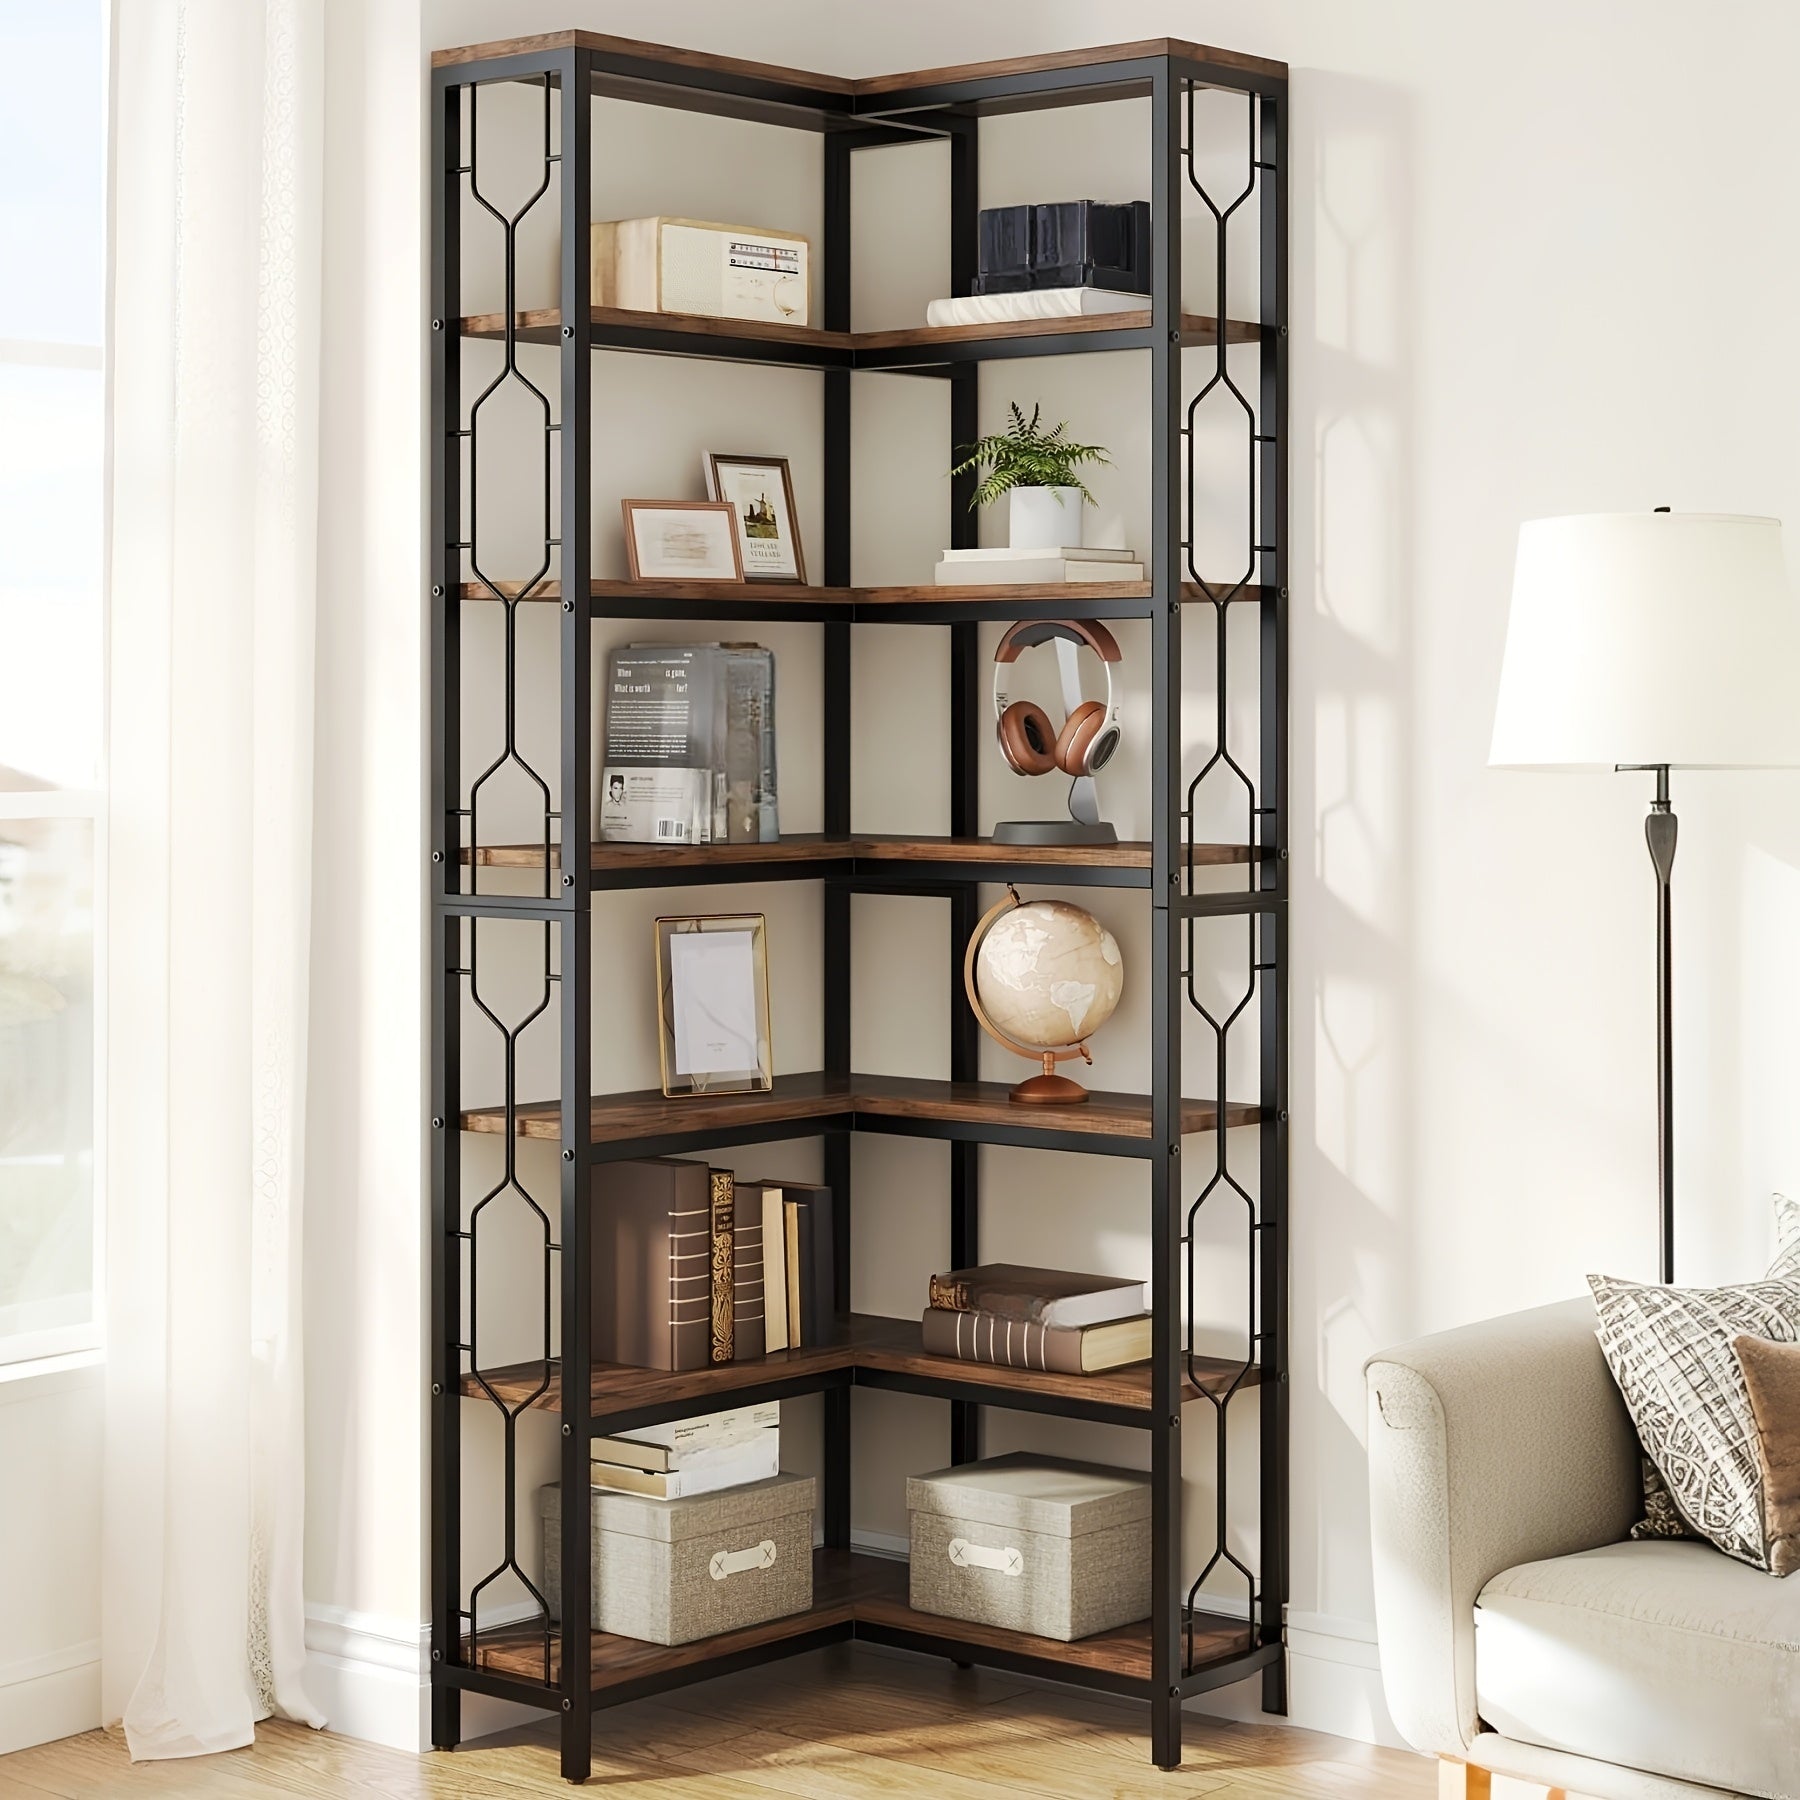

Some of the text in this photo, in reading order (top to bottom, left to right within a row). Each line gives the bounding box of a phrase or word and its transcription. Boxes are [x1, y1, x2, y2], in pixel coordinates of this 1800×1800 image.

[617, 669, 632, 677] When
[614, 684, 628, 693] What
[635, 684, 650, 693] worth
[676, 683, 688, 692] for?
